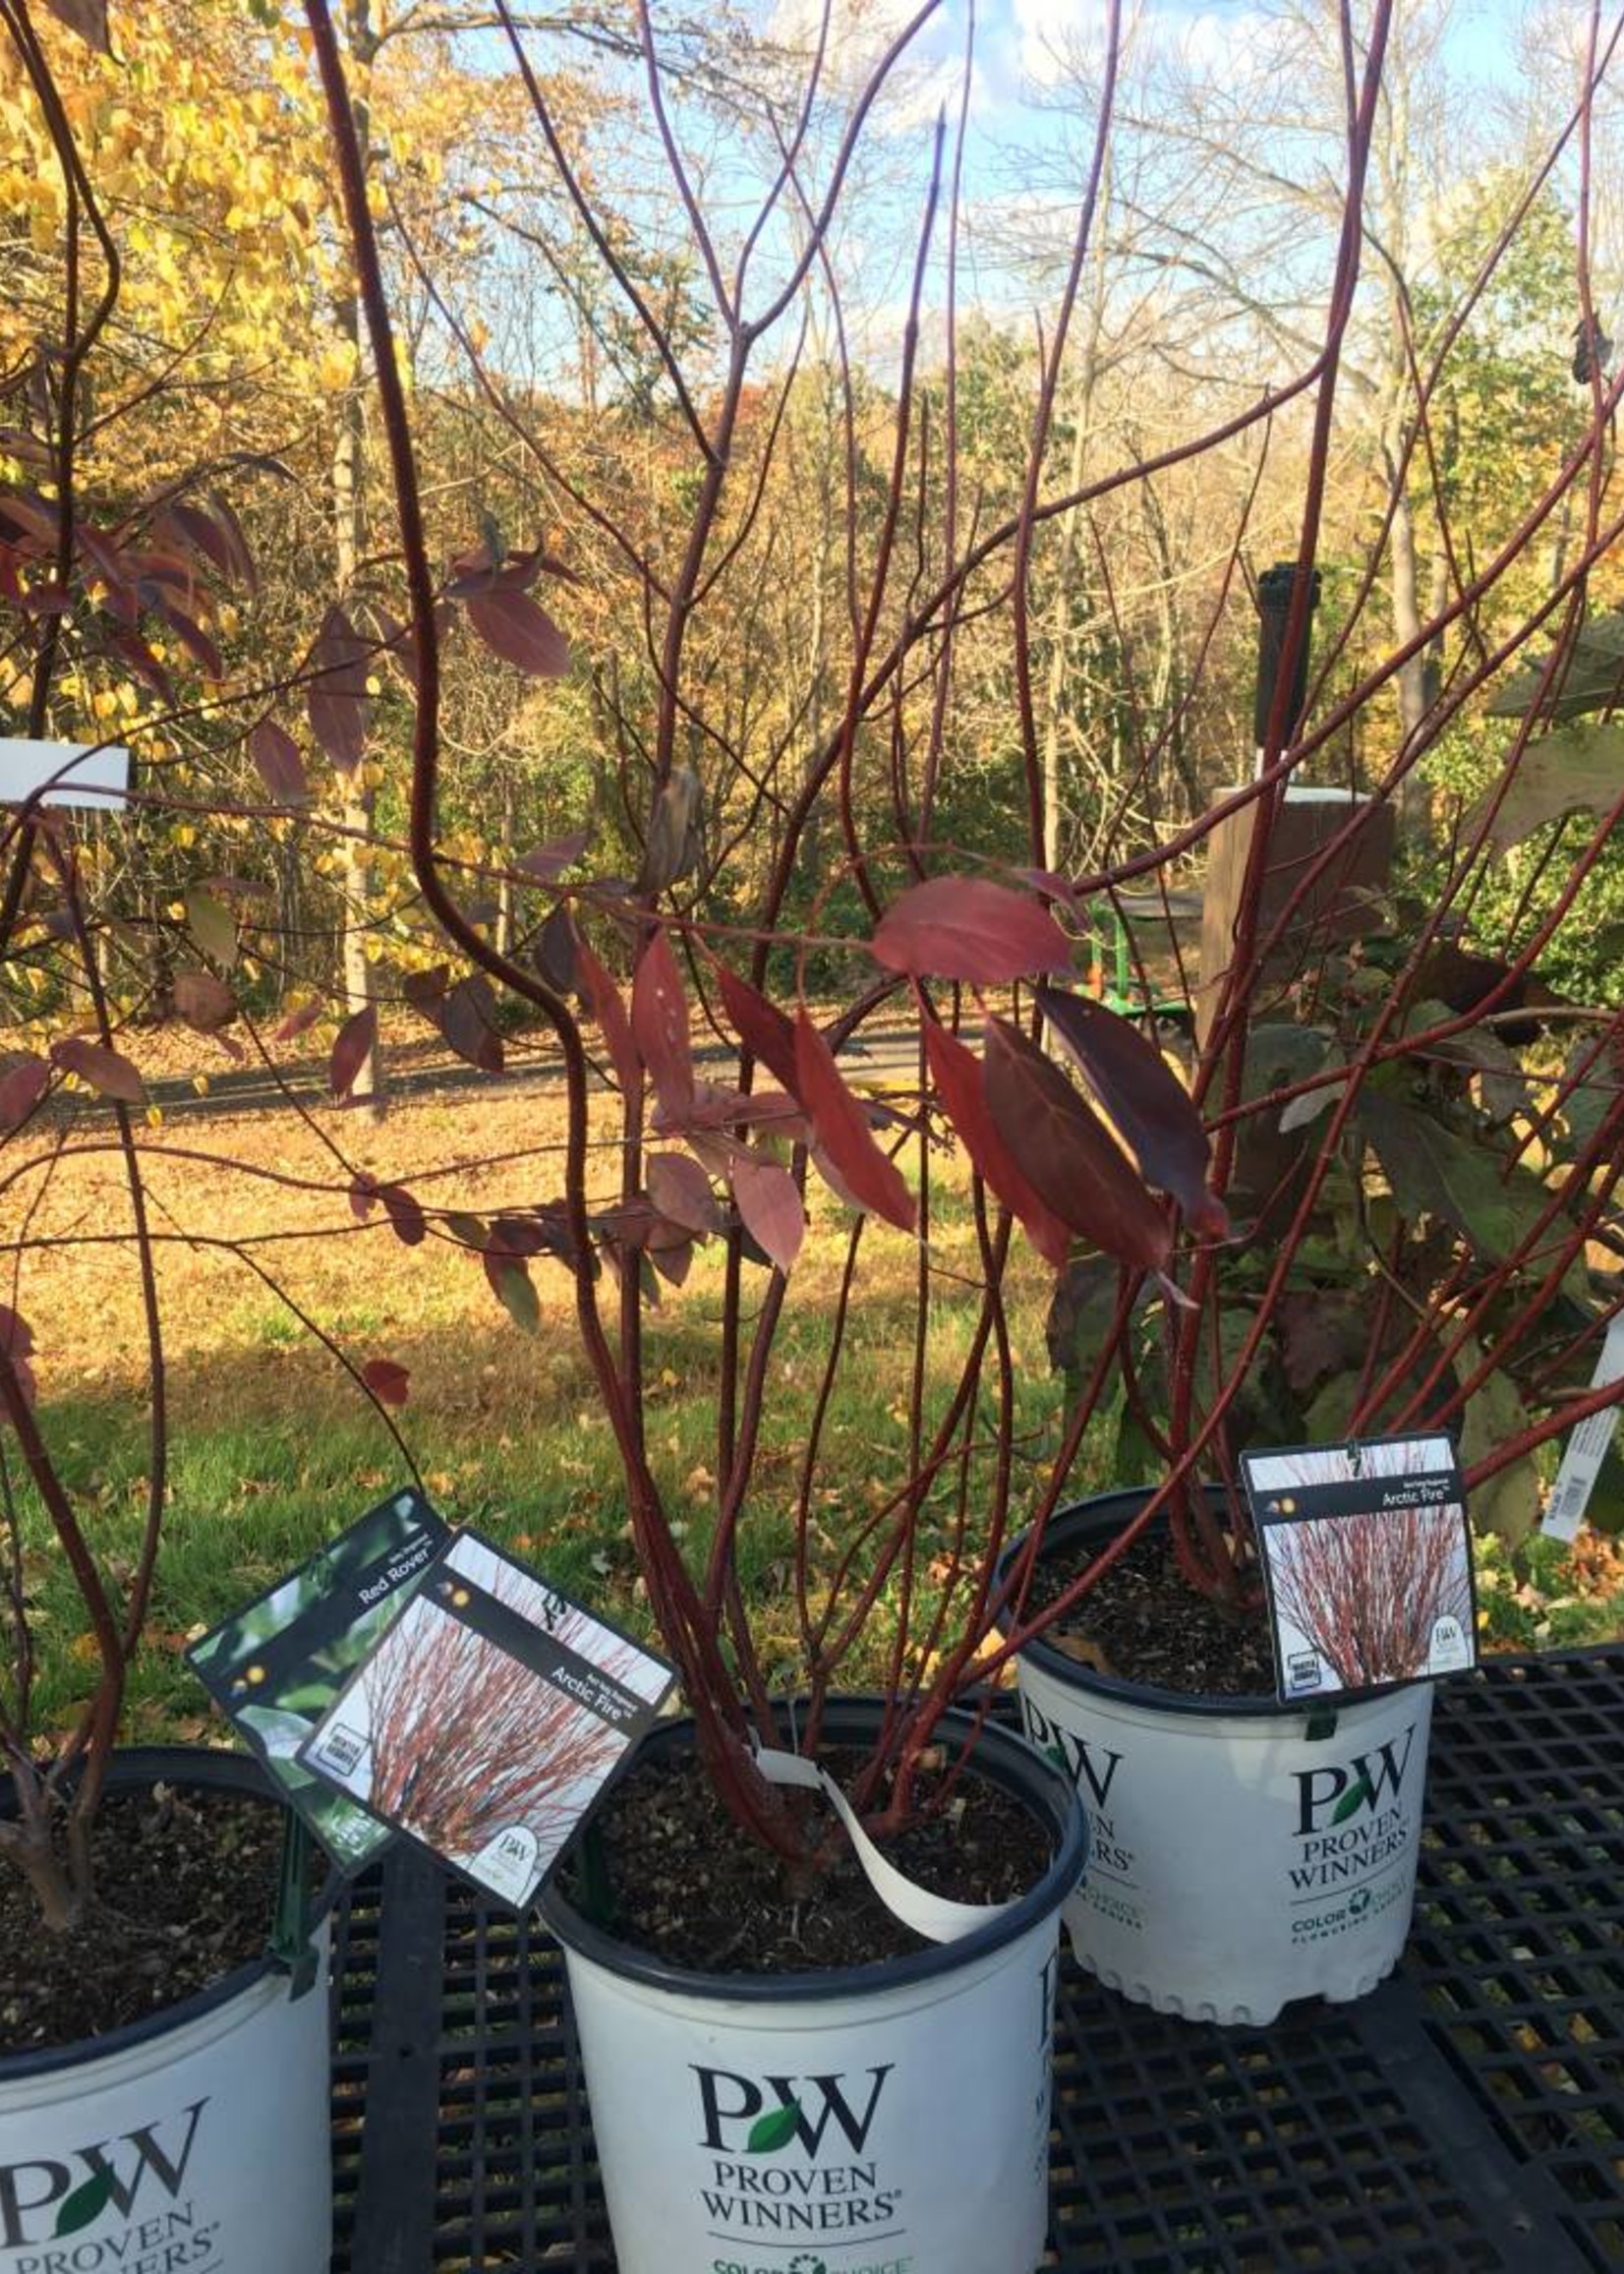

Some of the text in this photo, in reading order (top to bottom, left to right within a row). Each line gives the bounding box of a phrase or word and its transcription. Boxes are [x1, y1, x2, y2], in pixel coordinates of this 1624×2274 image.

[1382, 1490, 1420, 1507] Arctic
[358, 1576, 390, 1604] Red
[551, 1665, 595, 1703] Arctic
[1289, 1721, 1418, 1837] PW
[1303, 1798, 1401, 1863] PROVEN
[1291, 1906, 1347, 1934] COLOR
[687, 2062, 896, 2161] PW
[0, 2095, 212, 2249] PW
[713, 2161, 877, 2196] PROVEN
[16, 2201, 194, 2274] PROVEN
